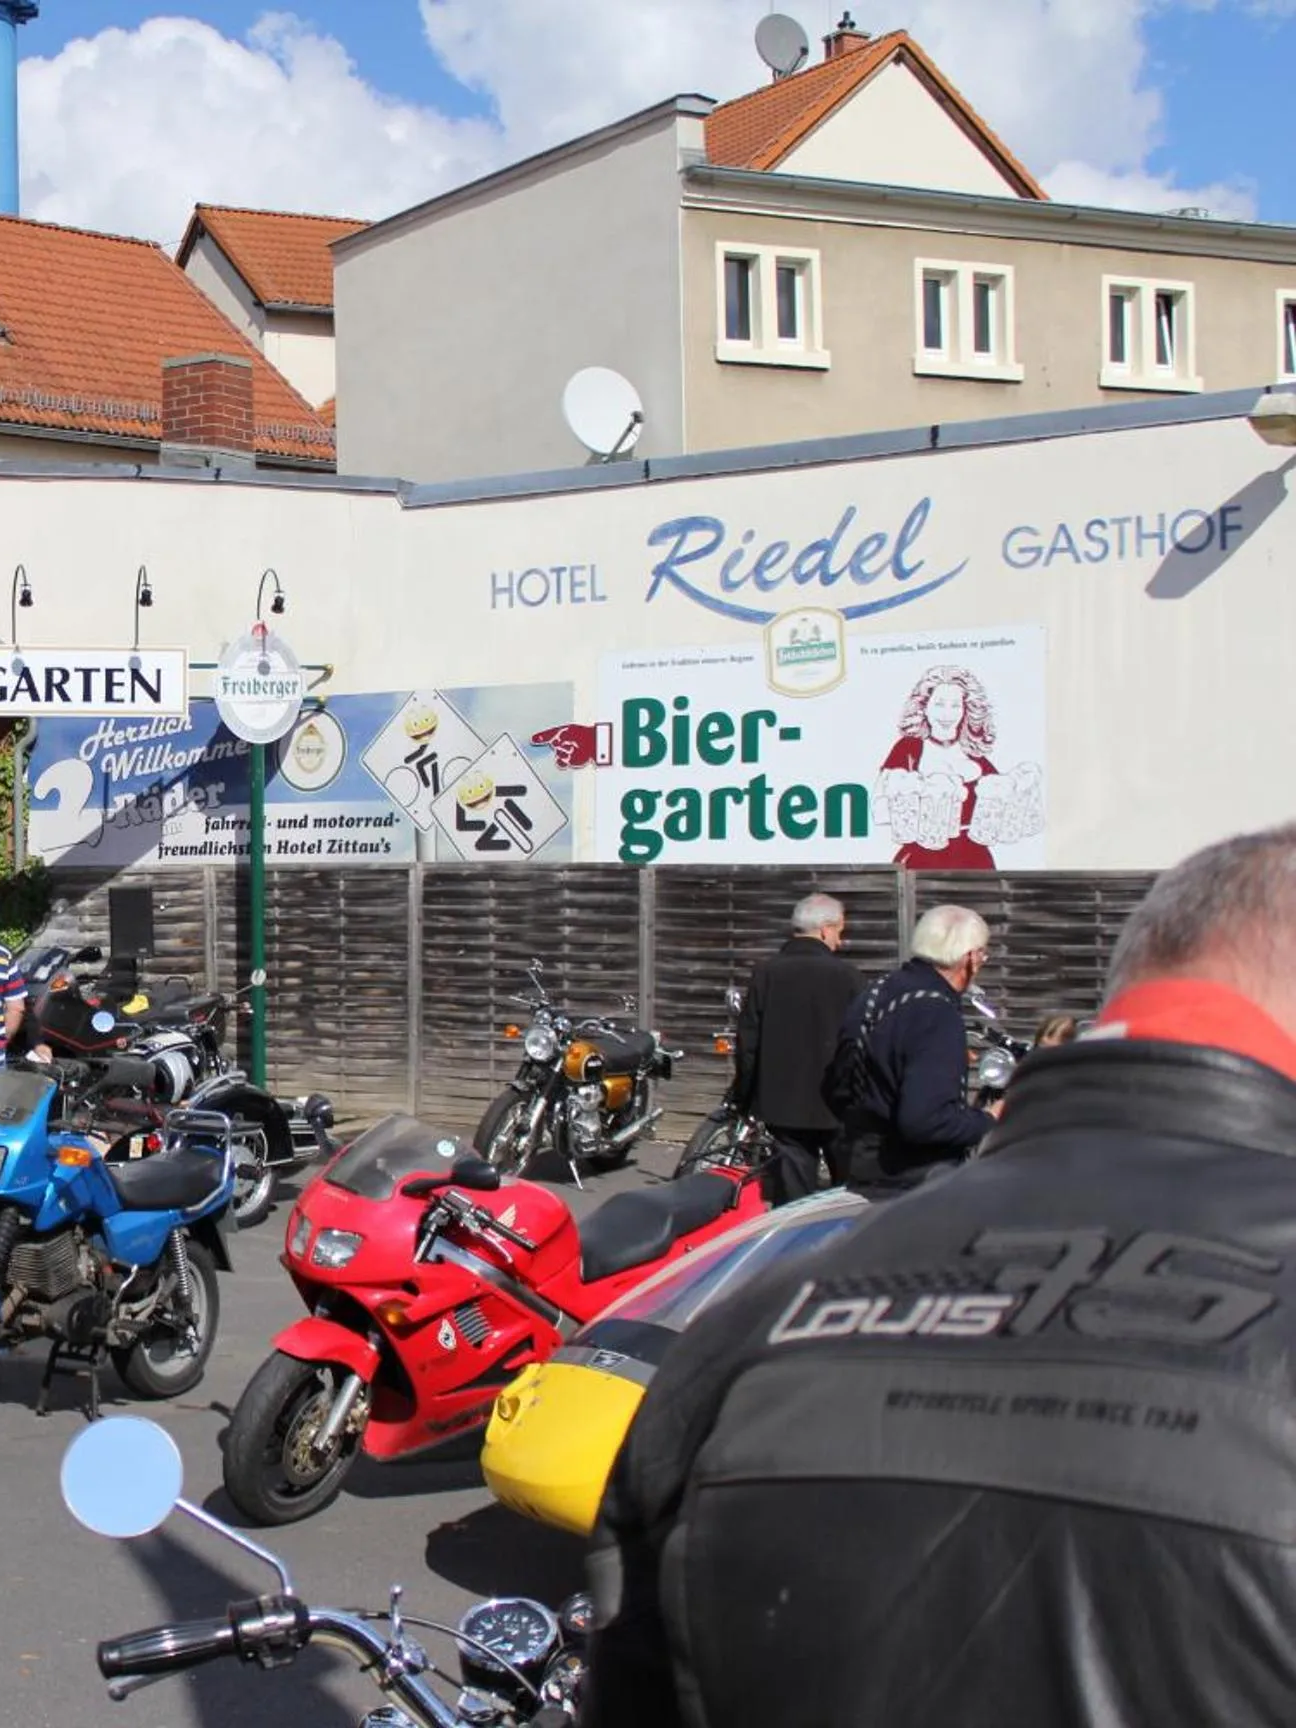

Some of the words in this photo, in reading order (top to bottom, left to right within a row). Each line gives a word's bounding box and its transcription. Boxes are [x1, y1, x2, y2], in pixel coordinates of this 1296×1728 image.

[645, 497, 954, 618] Riedel
[1002, 506, 1243, 569] GASTHOF
[490, 564, 607, 610] HOTEL
[221, 676, 299, 699] Freiberger
[79, 715, 193, 762] Herzlich
[621, 695, 802, 769] Bier-
[101, 739, 252, 782] Willkomme
[205, 815, 272, 835] fahrr-
[277, 815, 308, 829] und
[313, 812, 400, 829] motorrad-
[618, 773, 869, 866] garten
[157, 841, 272, 860] freundlichstn
[277, 839, 322, 856] Hotel
[327, 837, 392, 855] Zittau's
